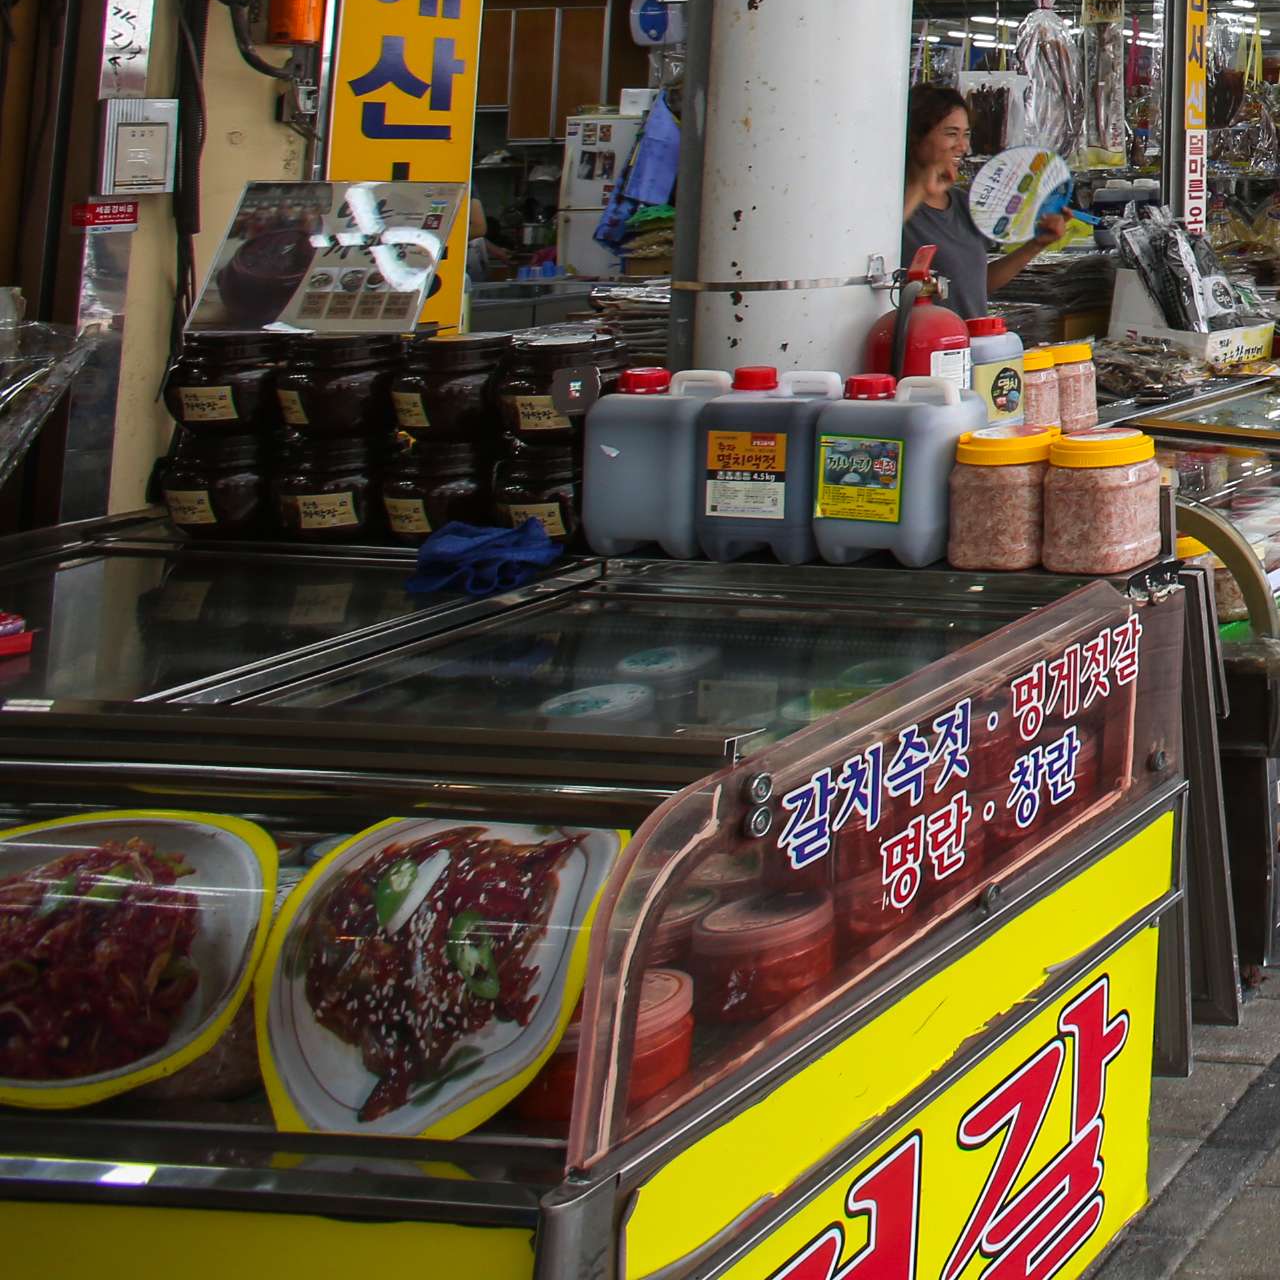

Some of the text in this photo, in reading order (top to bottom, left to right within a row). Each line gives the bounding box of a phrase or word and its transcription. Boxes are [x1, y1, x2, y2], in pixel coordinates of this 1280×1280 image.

[1187, 134, 1206, 234] 덜마른오
[716, 452, 777, 470] 멸치액젓
[768, 973, 1130, 1280] 갈
